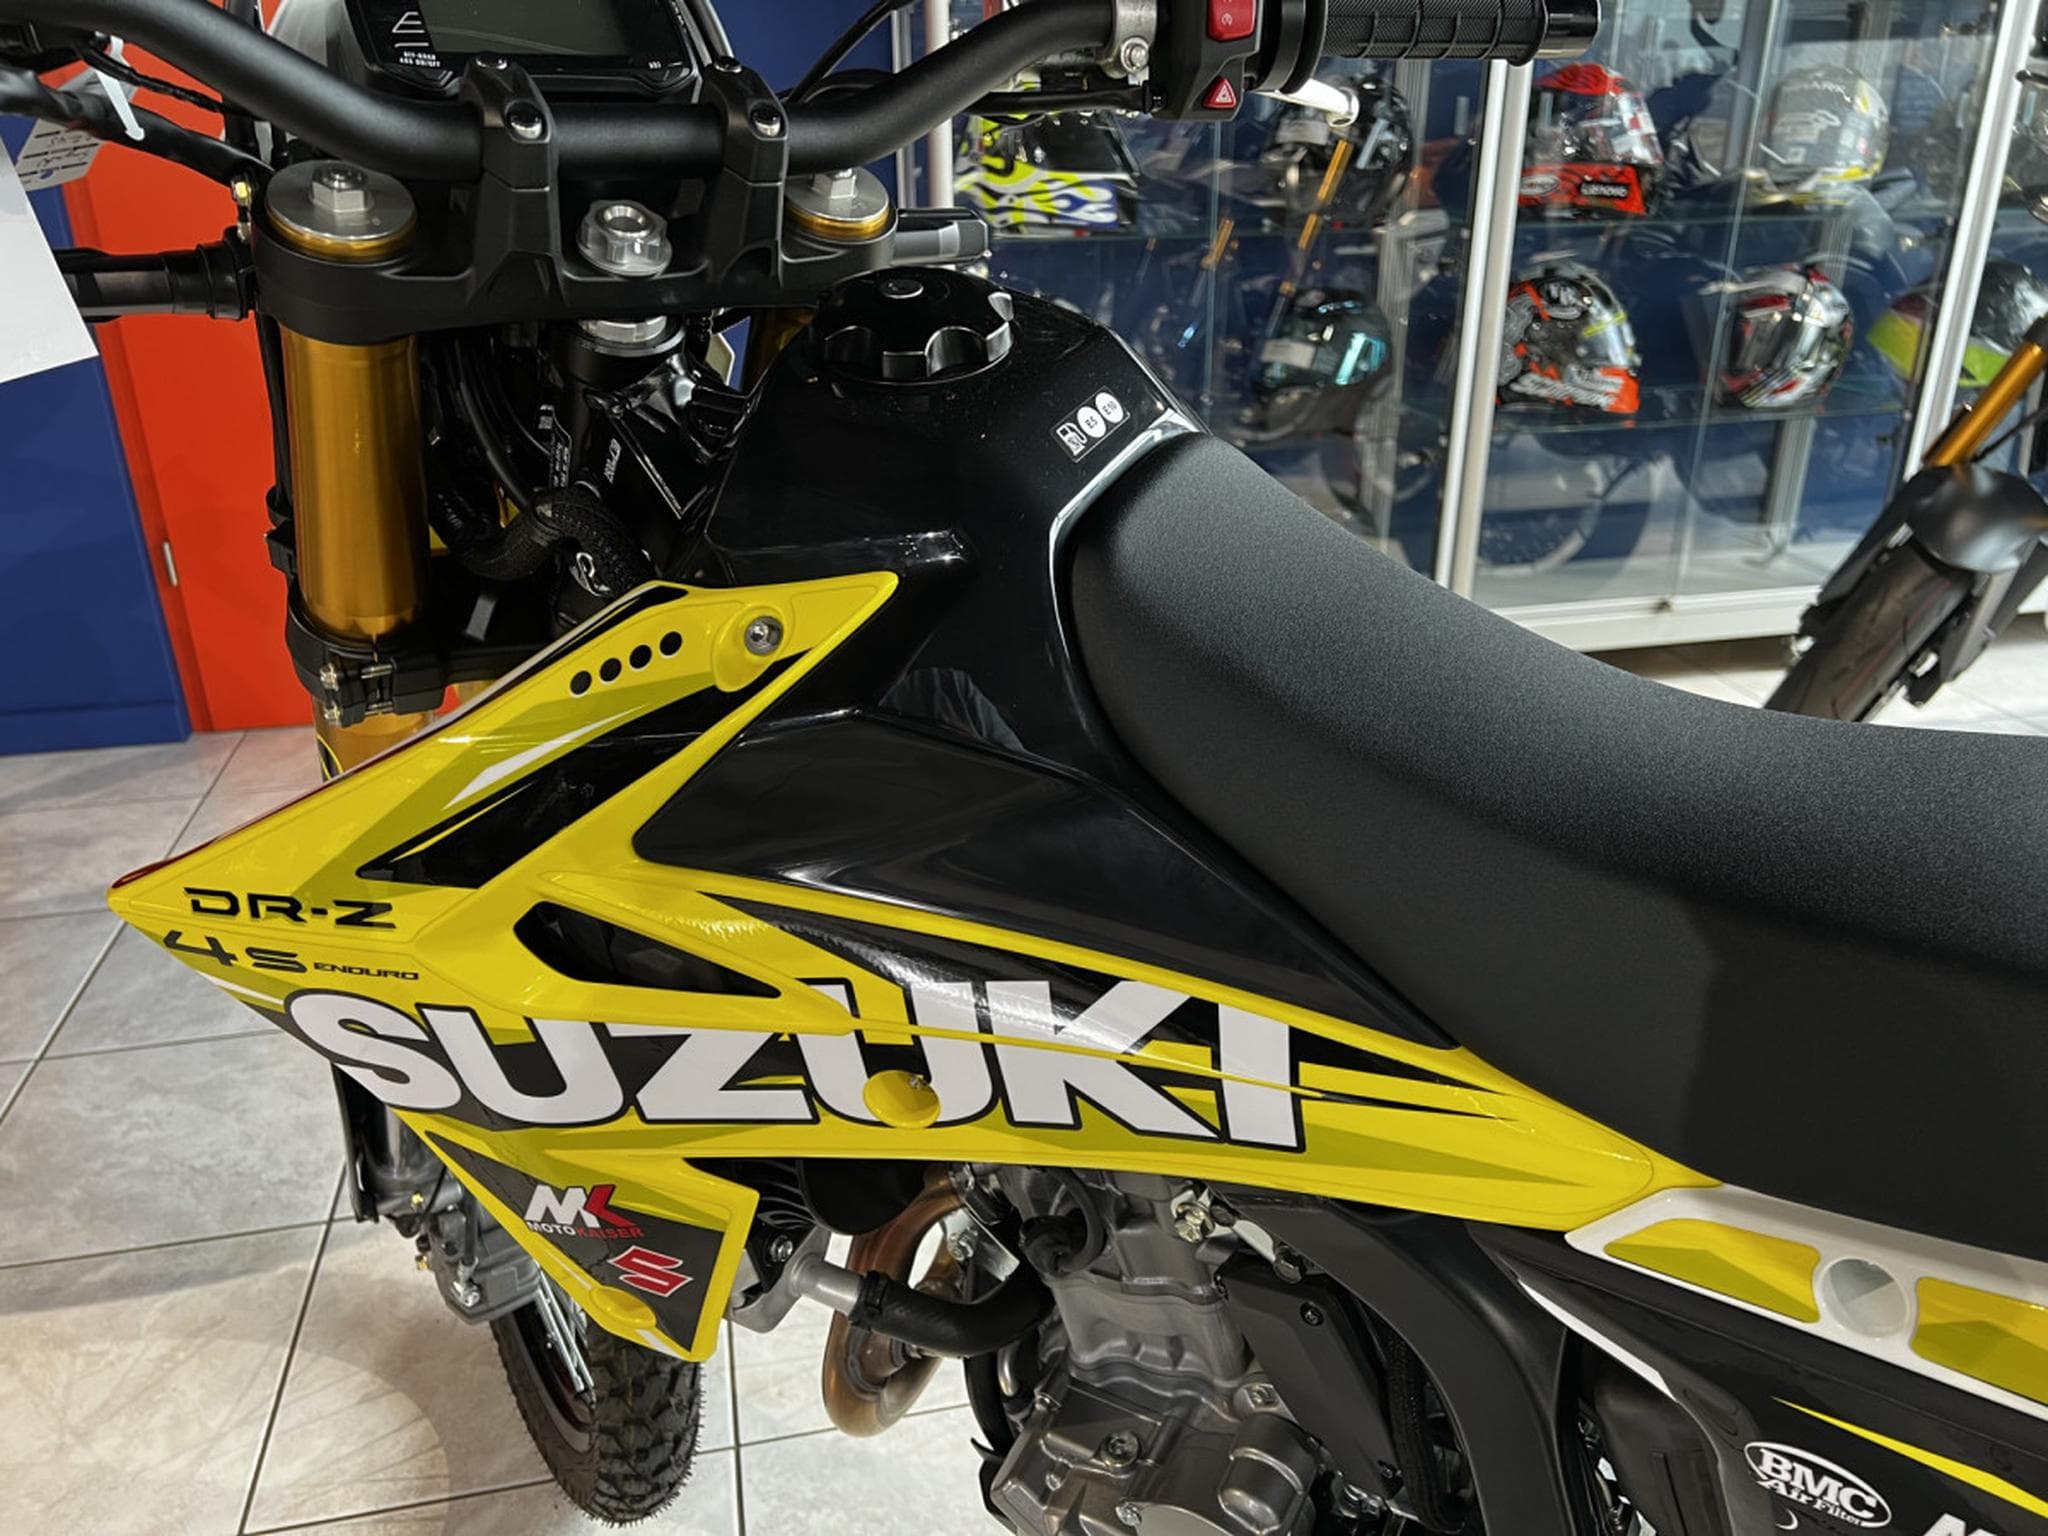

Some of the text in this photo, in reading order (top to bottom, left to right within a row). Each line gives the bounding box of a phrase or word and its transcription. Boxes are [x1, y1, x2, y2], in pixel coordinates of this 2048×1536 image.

[183, 886, 397, 931] DR-Z
[313, 961, 420, 981] ENDURO
[284, 977, 1304, 1152] SUZUKI
[1759, 1447, 1878, 1520] BMC
[1812, 1497, 1863, 1527] Filter
